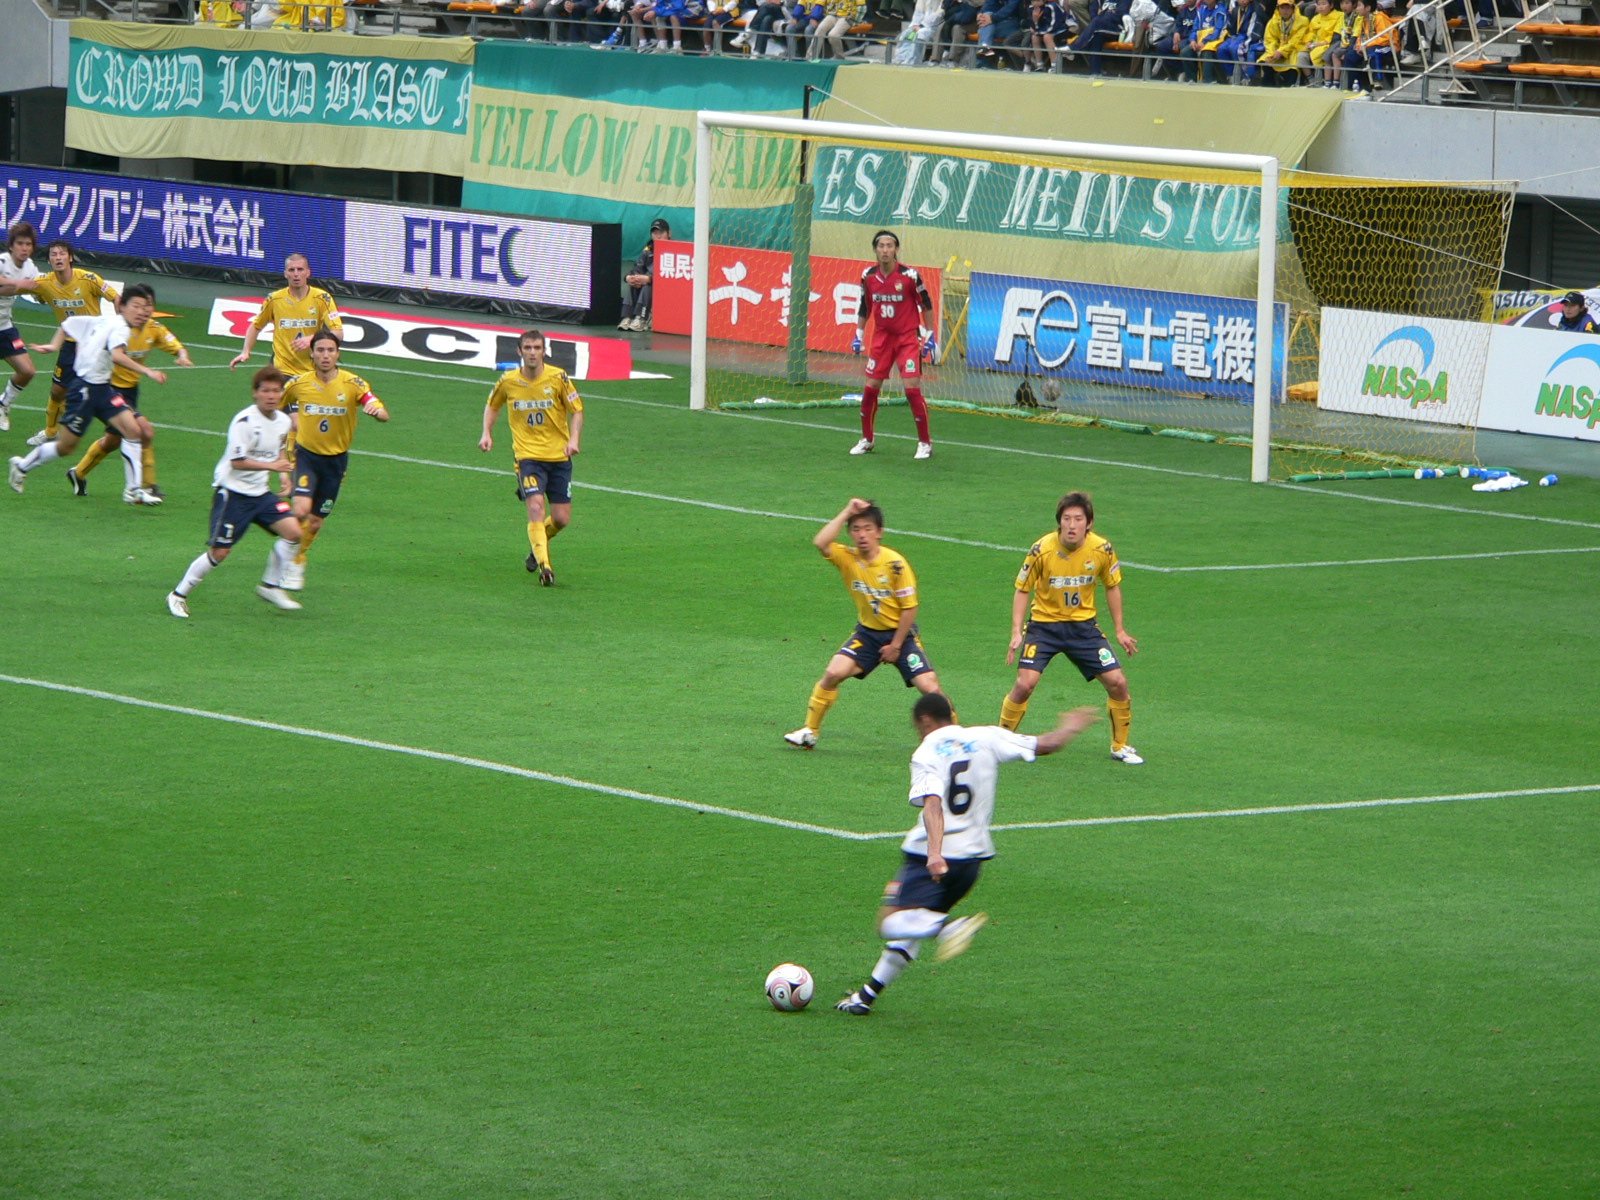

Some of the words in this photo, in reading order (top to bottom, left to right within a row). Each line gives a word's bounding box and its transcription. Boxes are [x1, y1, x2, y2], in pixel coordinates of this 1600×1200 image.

[76, 47, 204, 111] CROWD
[216, 56, 317, 117] LOUD
[323, 61, 448, 125] BLAST
[470, 103, 638, 185] YELLOW
[820, 148, 884, 218] ES
[892, 153, 991, 223] IST
[999, 164, 1136, 239] MEIN
[1140, 179, 1281, 246] STOL
[403, 216, 529, 288] FITEC
[880, 304, 895, 319] 30
[1086, 301, 1254, 383] 富士電機
[319, 419, 330, 433] 6
[527, 412, 544, 427] 40
[299, 475, 309, 487] 6
[1063, 592, 1080, 607] 16
[851, 640, 863, 650] 7
[1024, 644, 1037, 658] 16
[947, 760, 975, 815] 6
